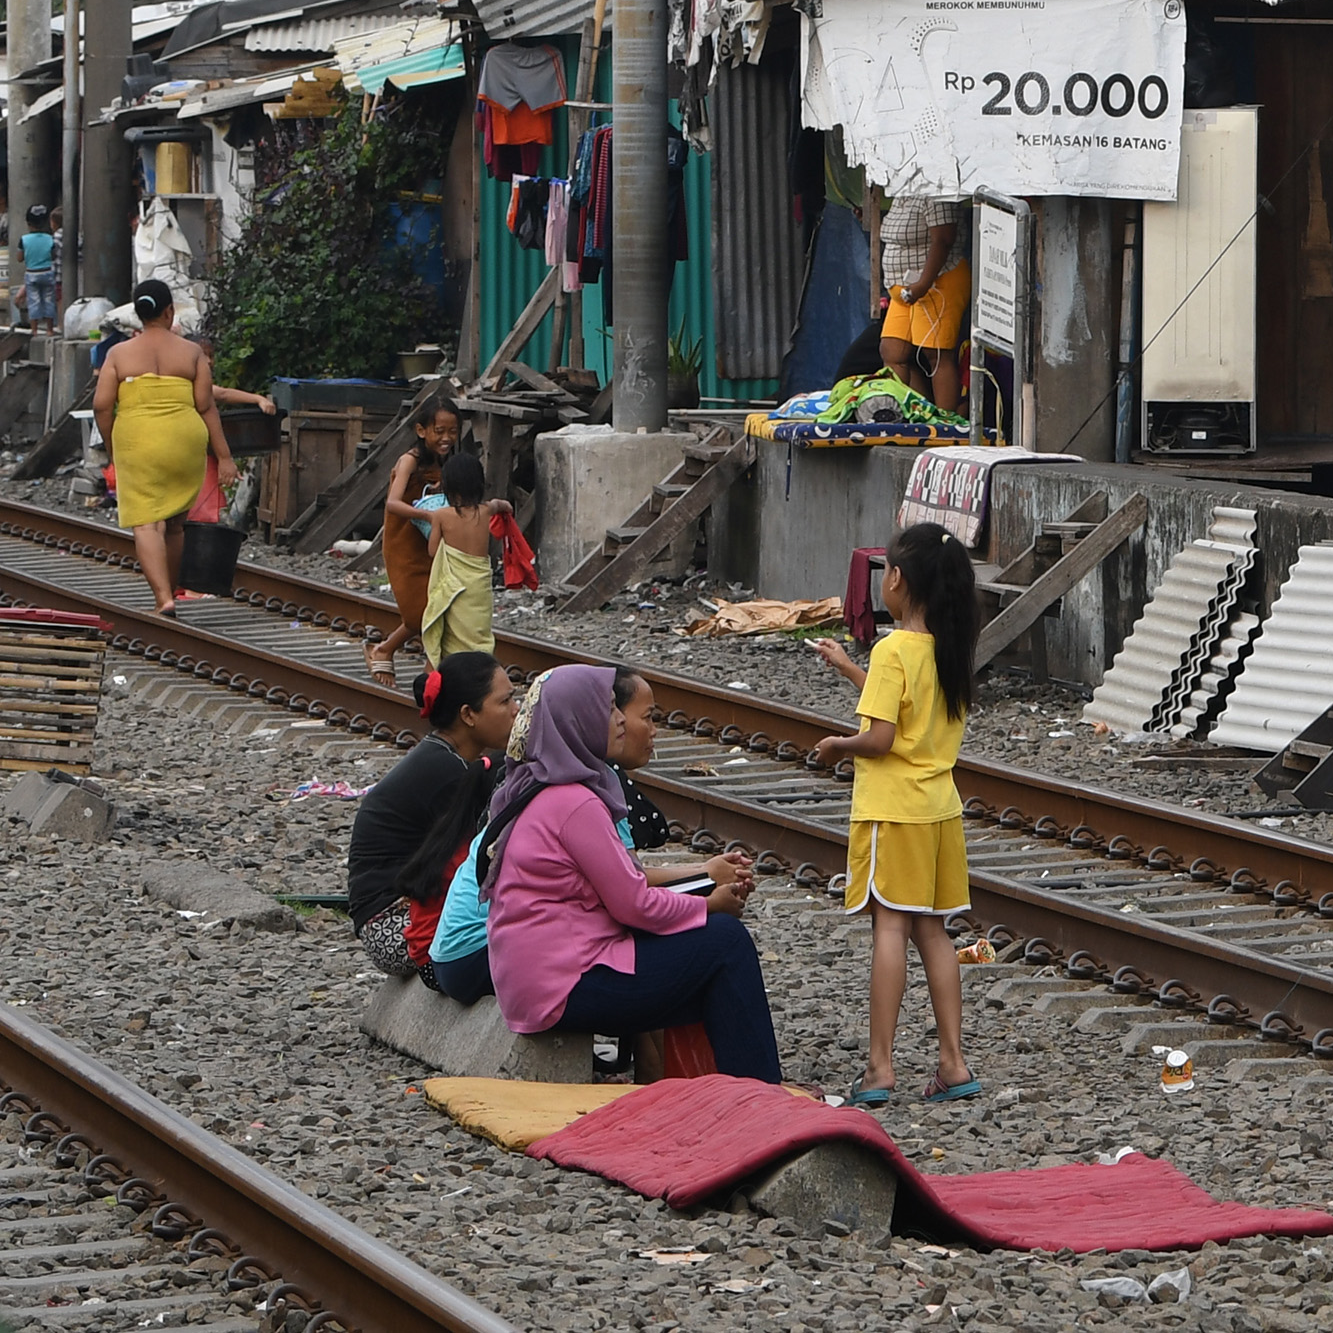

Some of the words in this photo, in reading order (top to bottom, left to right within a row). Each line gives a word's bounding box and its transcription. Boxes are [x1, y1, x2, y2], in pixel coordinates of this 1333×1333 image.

[926, 1, 974, 10] MEROKOK
[976, 1, 1045, 10] MEMBUNUHMU
[944, 72, 975, 95] Rp
[982, 71, 1169, 120] 20.000
[1096, 136, 1109, 147] 16
